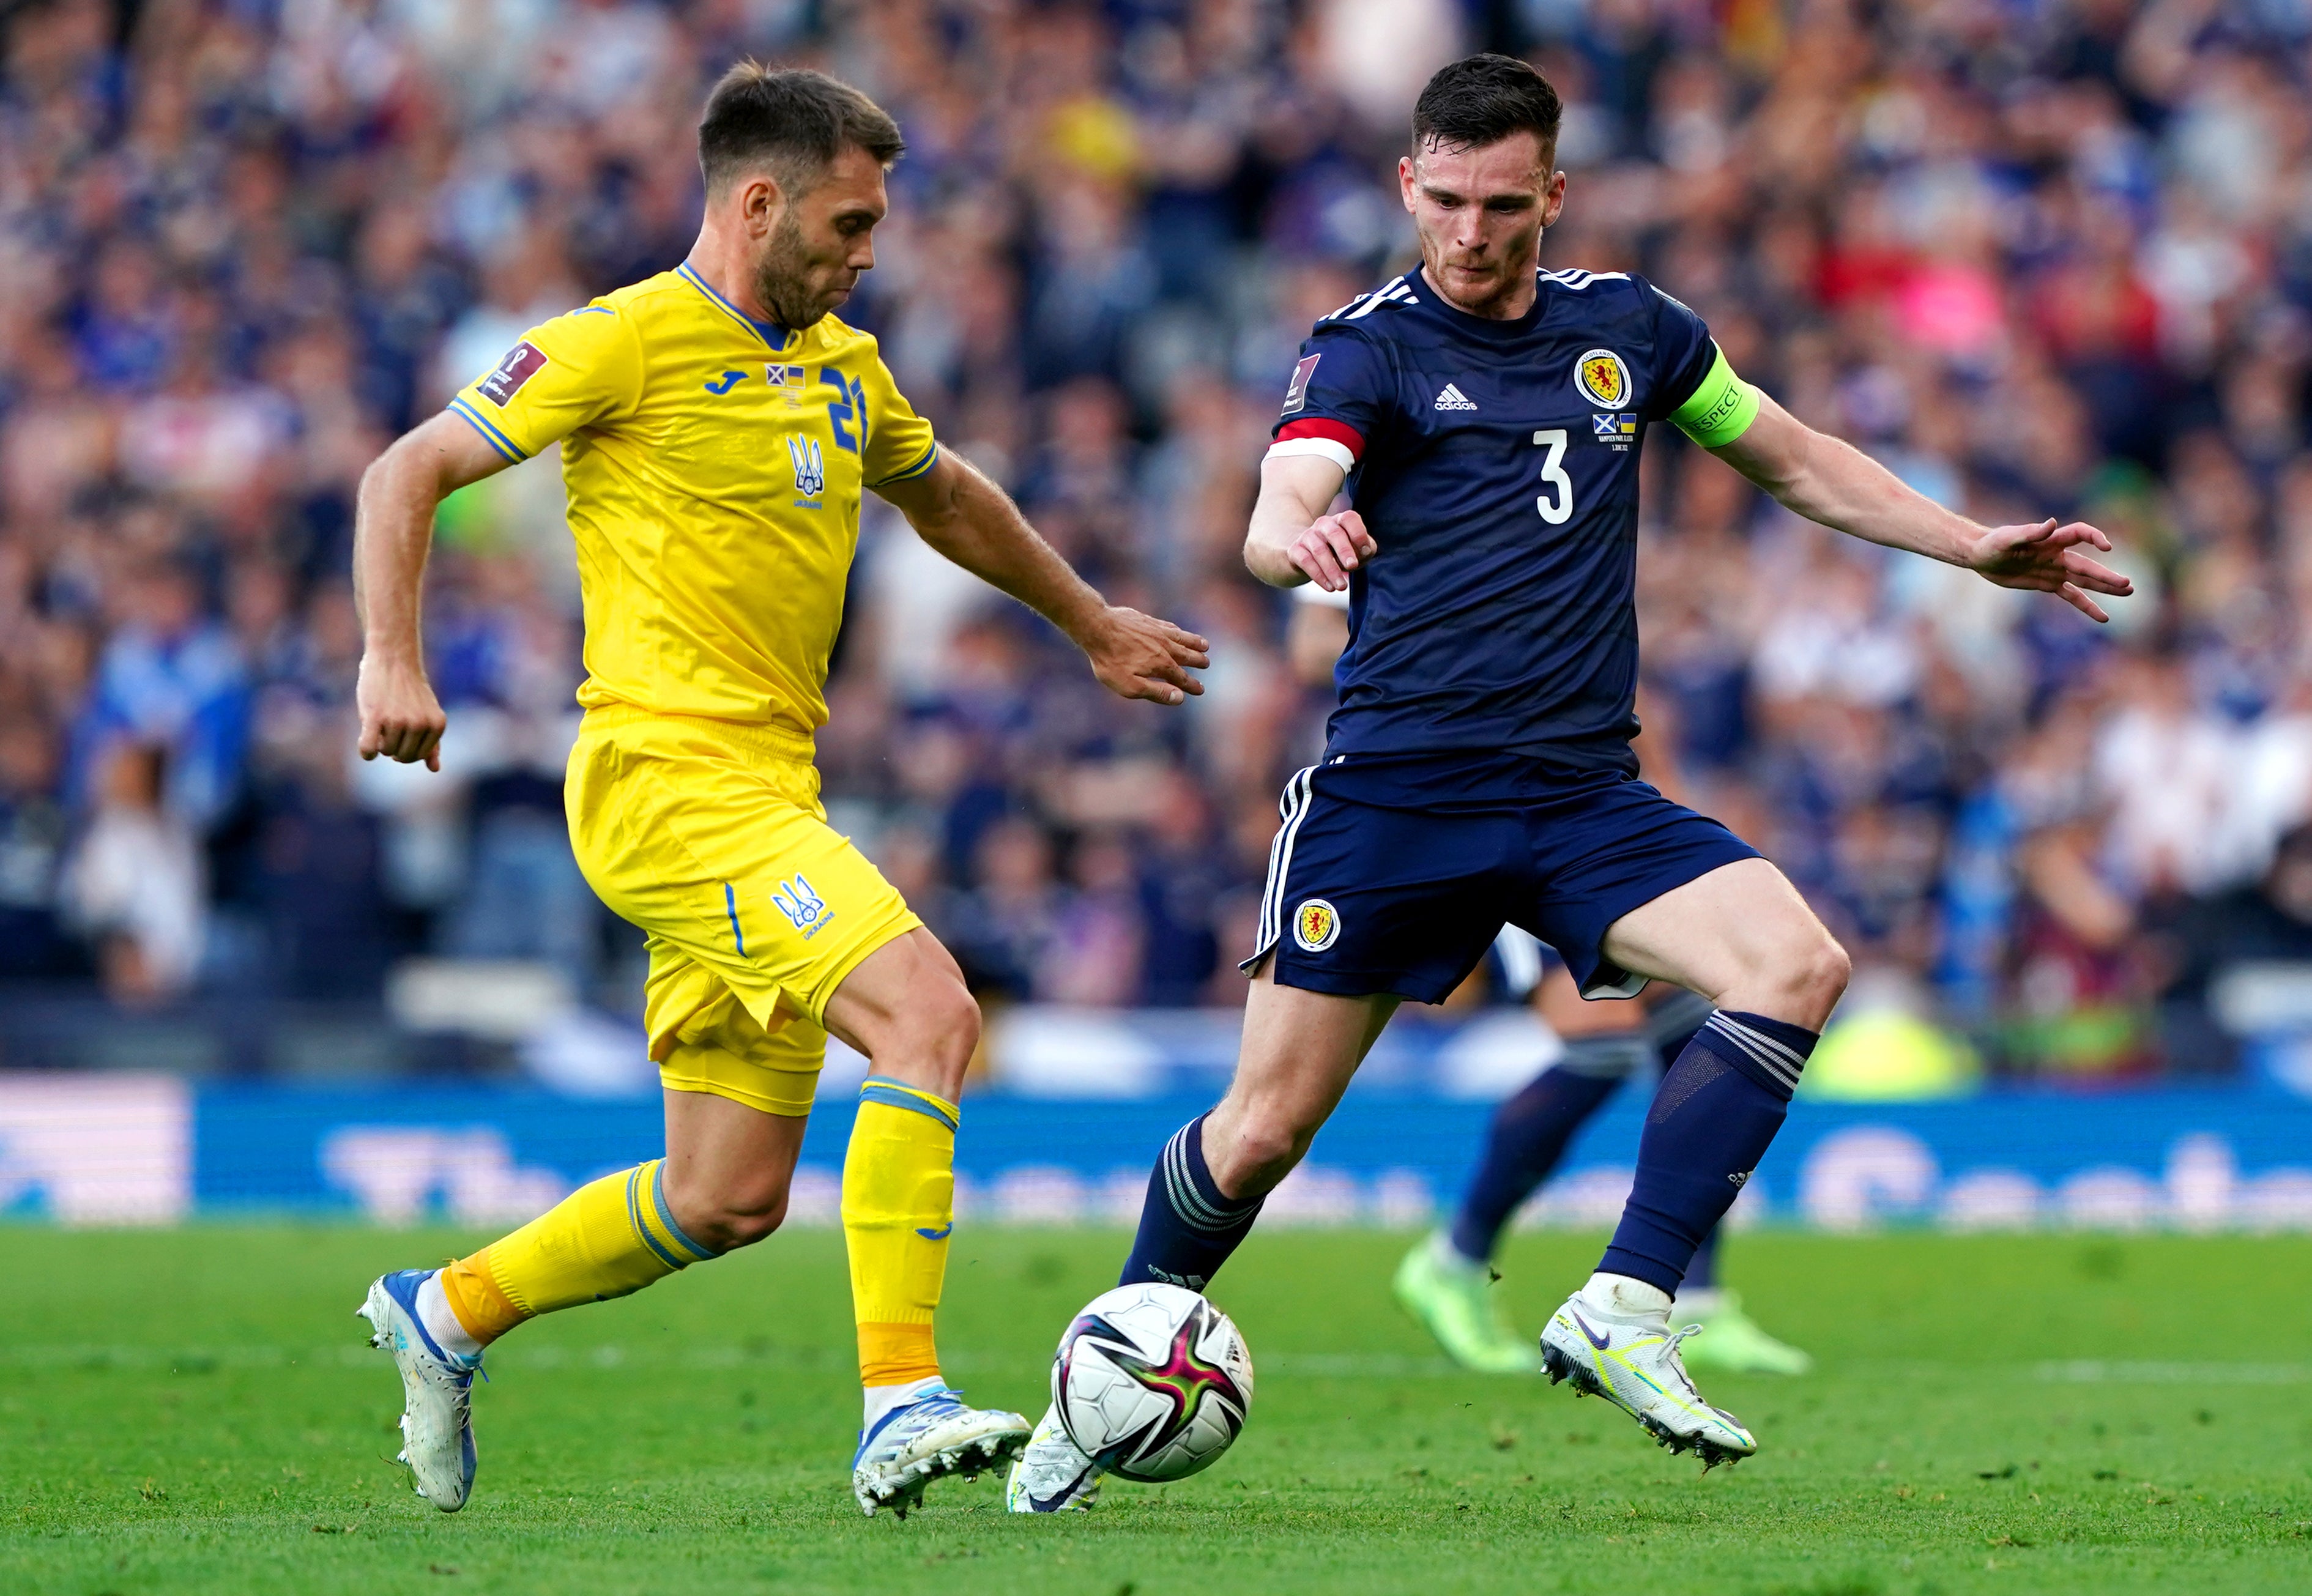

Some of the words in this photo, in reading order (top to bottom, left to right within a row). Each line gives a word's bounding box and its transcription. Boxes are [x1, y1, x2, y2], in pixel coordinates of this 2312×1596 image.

[1583, 351, 1611, 362] SCOTLAND
[819, 365, 868, 456] 21
[1434, 401, 1478, 410] adidas
[1533, 429, 1573, 525] 3
[803, 911, 836, 940] UKRAINE
